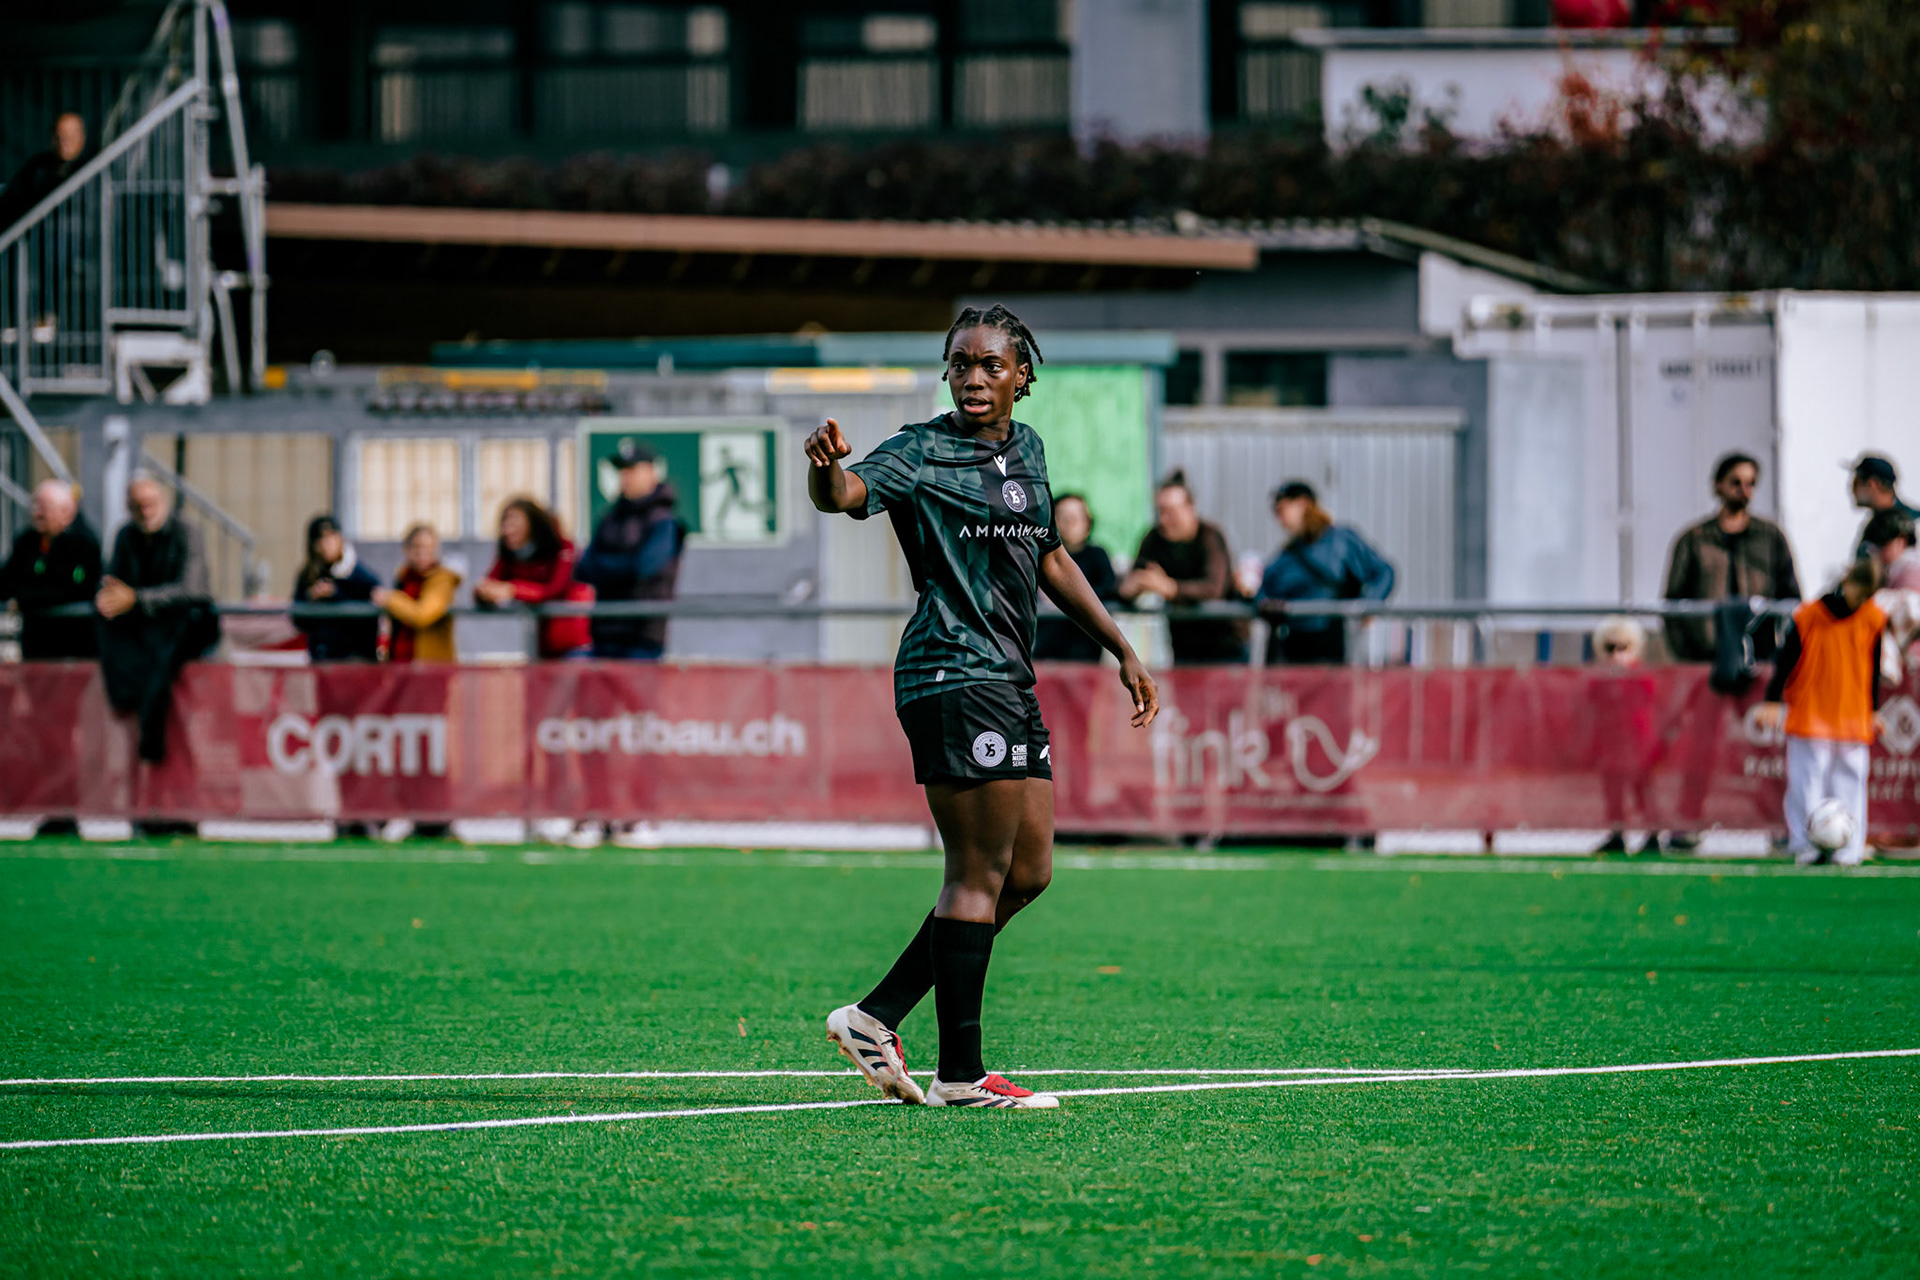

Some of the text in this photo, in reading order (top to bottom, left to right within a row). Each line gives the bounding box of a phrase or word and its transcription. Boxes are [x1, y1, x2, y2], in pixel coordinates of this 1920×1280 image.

[267, 713, 447, 777] CORTI
[537, 711, 806, 756] cortibau.ch
[1152, 705, 1272, 788] fink
